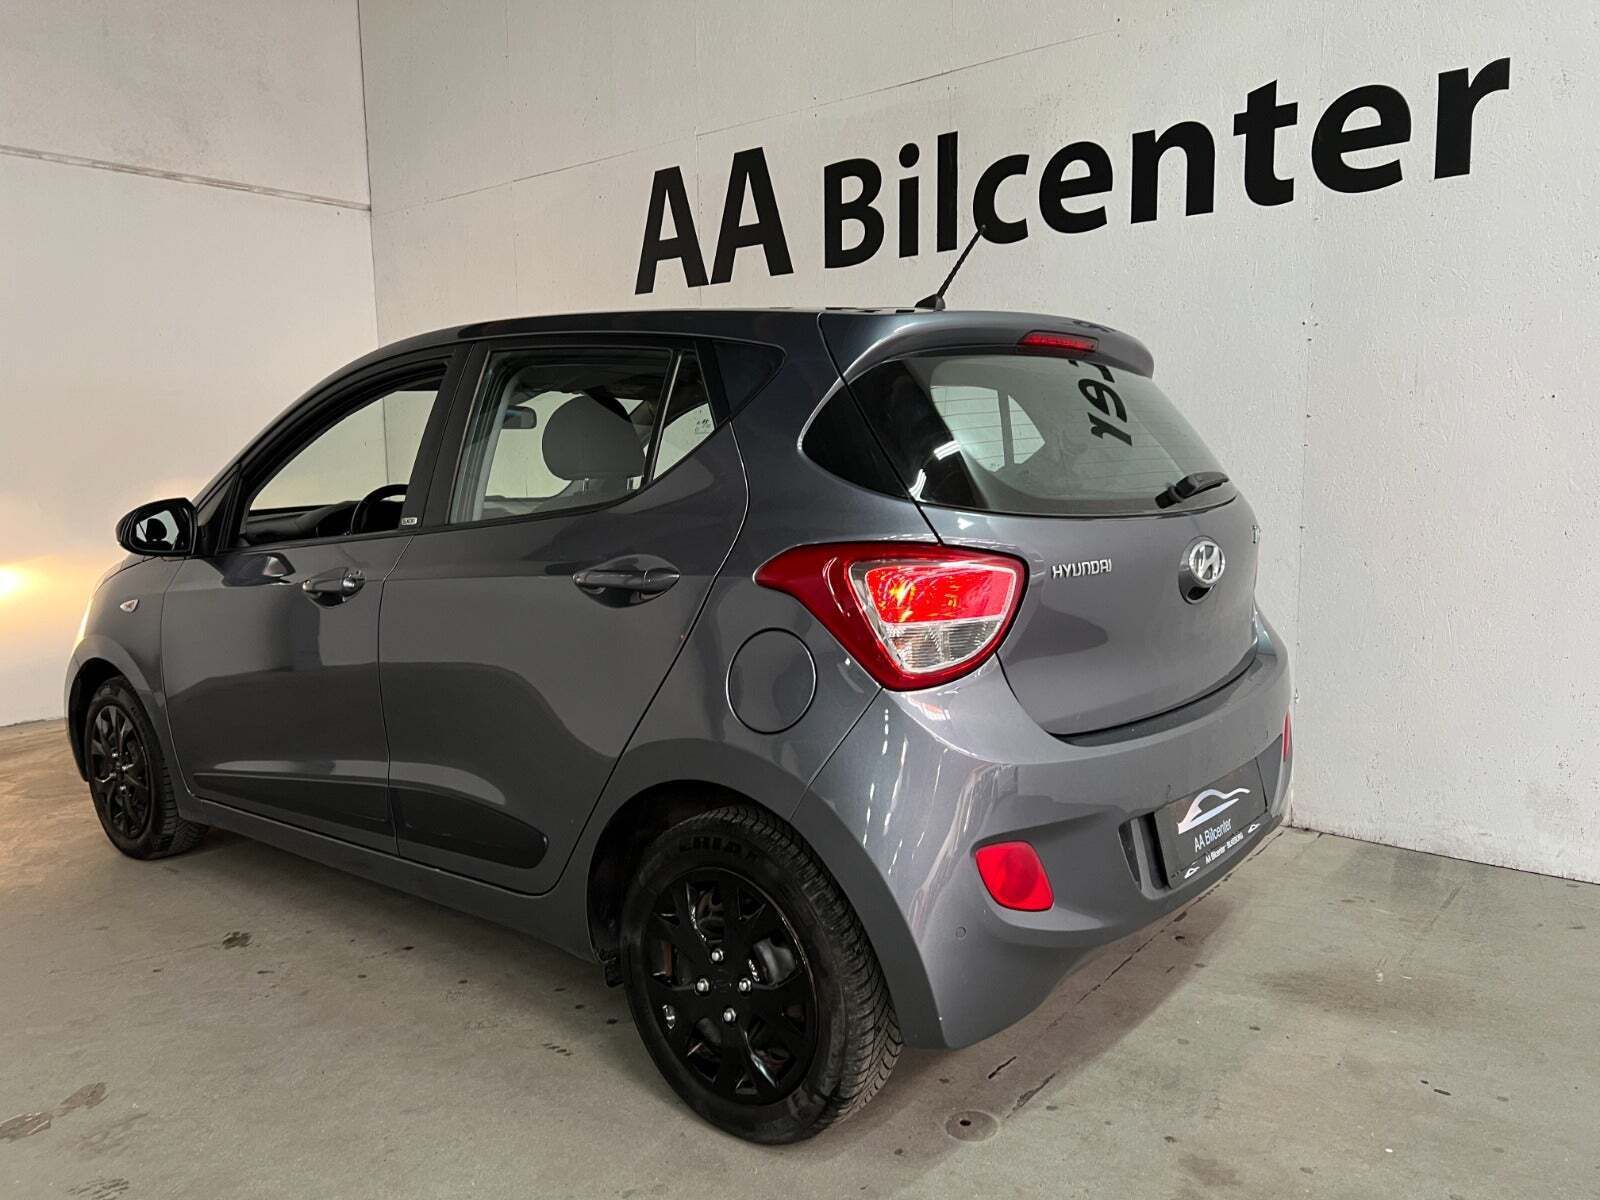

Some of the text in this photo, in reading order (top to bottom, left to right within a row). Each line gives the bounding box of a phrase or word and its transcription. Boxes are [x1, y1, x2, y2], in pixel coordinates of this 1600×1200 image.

[634, 57, 1511, 295] AA Bilcenter
[1052, 558, 1112, 579] HYUNDAI
[1194, 833, 1206, 853] AA
[1204, 817, 1232, 845] Bilcenter
